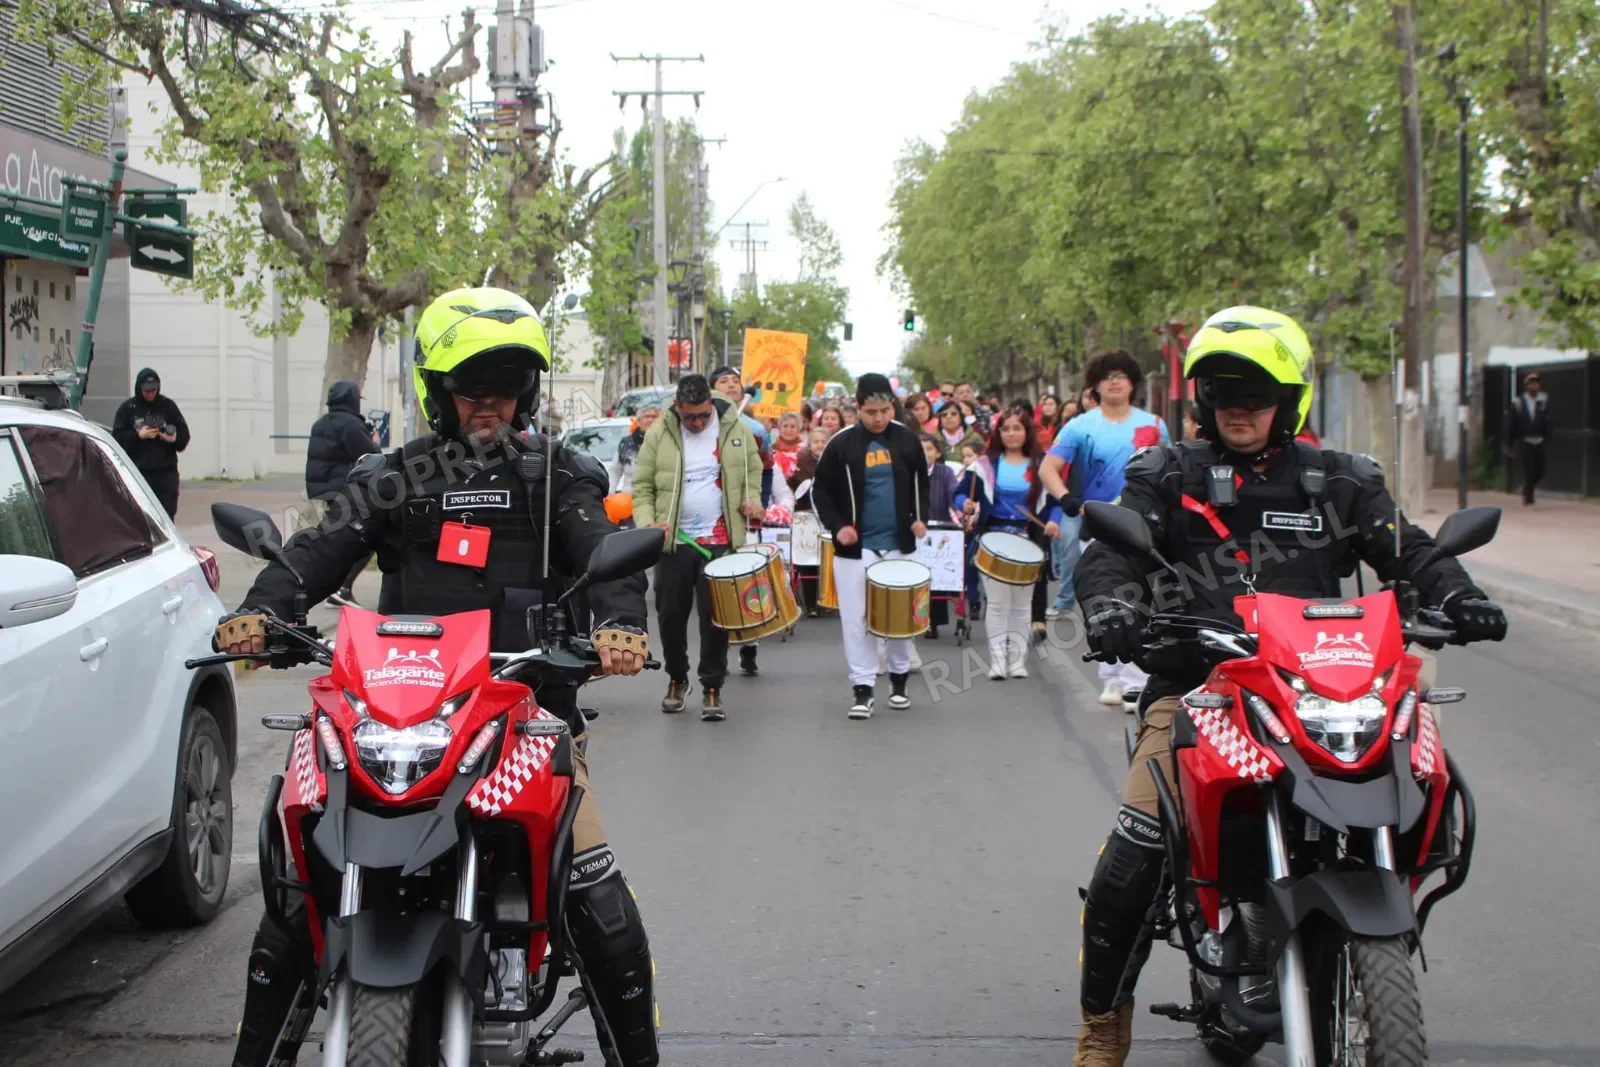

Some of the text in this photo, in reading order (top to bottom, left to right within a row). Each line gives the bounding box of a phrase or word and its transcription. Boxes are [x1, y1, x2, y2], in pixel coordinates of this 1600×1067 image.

[4, 214, 23, 226] PJE.
[450, 495, 502, 504] INSPECTOR
[1296, 650, 1374, 663] Talagante
[363, 668, 445, 681] Talagante
[363, 677, 401, 689] Creciendo
[420, 679, 445, 688] todos
[580, 856, 608, 873] VEMAR
